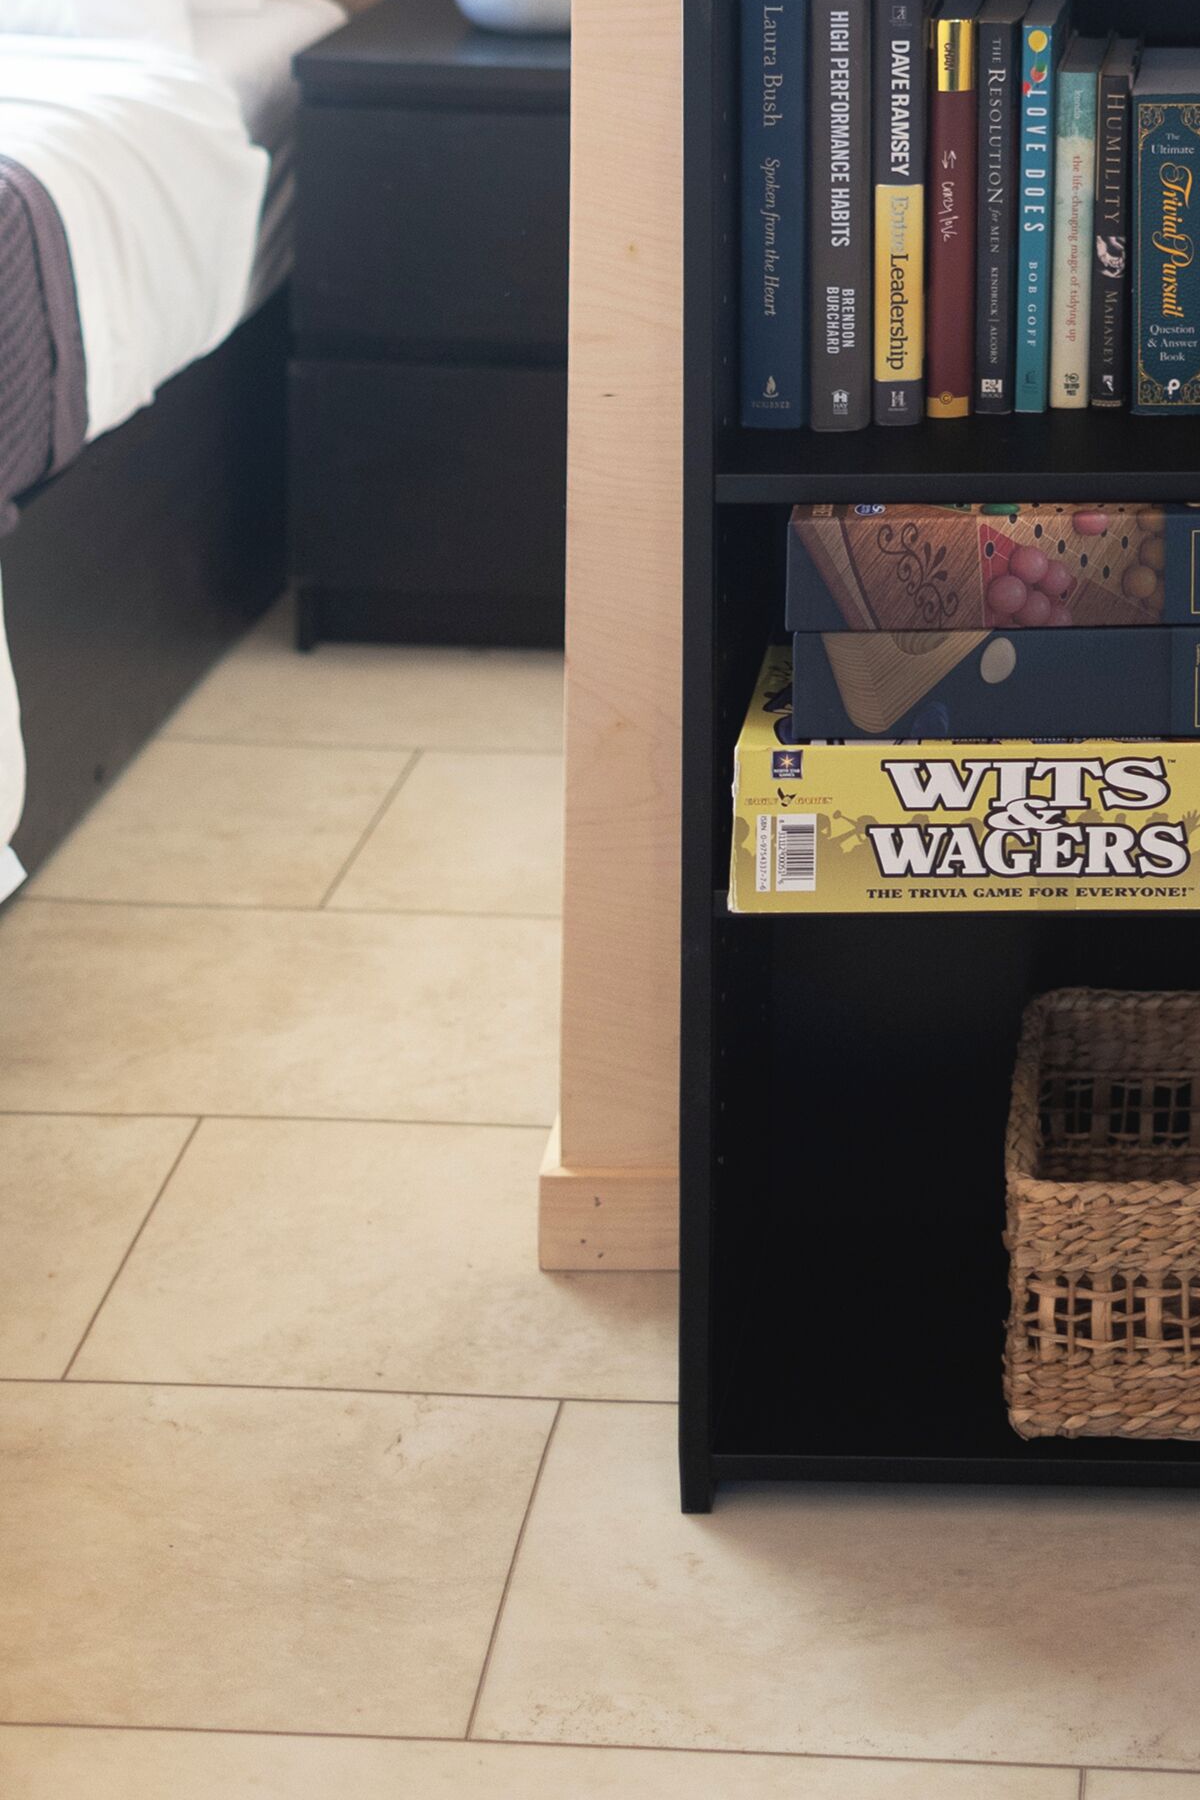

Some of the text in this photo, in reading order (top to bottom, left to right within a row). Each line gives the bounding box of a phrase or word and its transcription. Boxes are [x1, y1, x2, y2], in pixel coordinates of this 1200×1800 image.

[762, 5, 784, 127] Laura Bush
[891, 40, 911, 90] DAVE
[991, 39, 1002, 64] THE
[829, 10, 851, 249] HIGH PERFORMANCE HABITS
[891, 94, 910, 177] RAMSEY
[1151, 143, 1195, 156] Ultimate
[1166, 132, 1181, 142] The
[1023, 90, 1048, 233] LOVE DOES
[1072, 155, 1083, 173] the
[1104, 93, 1126, 224] HUMILITY
[760, 157, 781, 317] Spoken from the Heart
[988, 208, 1003, 223] for
[989, 225, 1000, 254] MEN
[1067, 243, 1079, 274] magic
[1152, 161, 1195, 319] Trivial Pursuit
[1069, 275, 1080, 287] of
[826, 286, 840, 355] BURCHARD
[841, 288, 855, 349] BRENDON
[989, 266, 1000, 364] KENDRICK ALCORN
[1026, 261, 1038, 348] BOB GOFF
[1066, 289, 1080, 326] tidying
[1065, 328, 1077, 342] up
[1103, 289, 1120, 366] MAHANEY
[1147, 337, 1198, 349] & Answer
[1149, 323, 1196, 337] Question
[1159, 351, 1186, 362] Book
[880, 756, 1171, 811] WITS
[983, 796, 1066, 832] &
[866, 821, 1191, 878] WAGERS
[866, 886, 1187, 899] THE TRIVIA GAME FOR EVERYONE!
